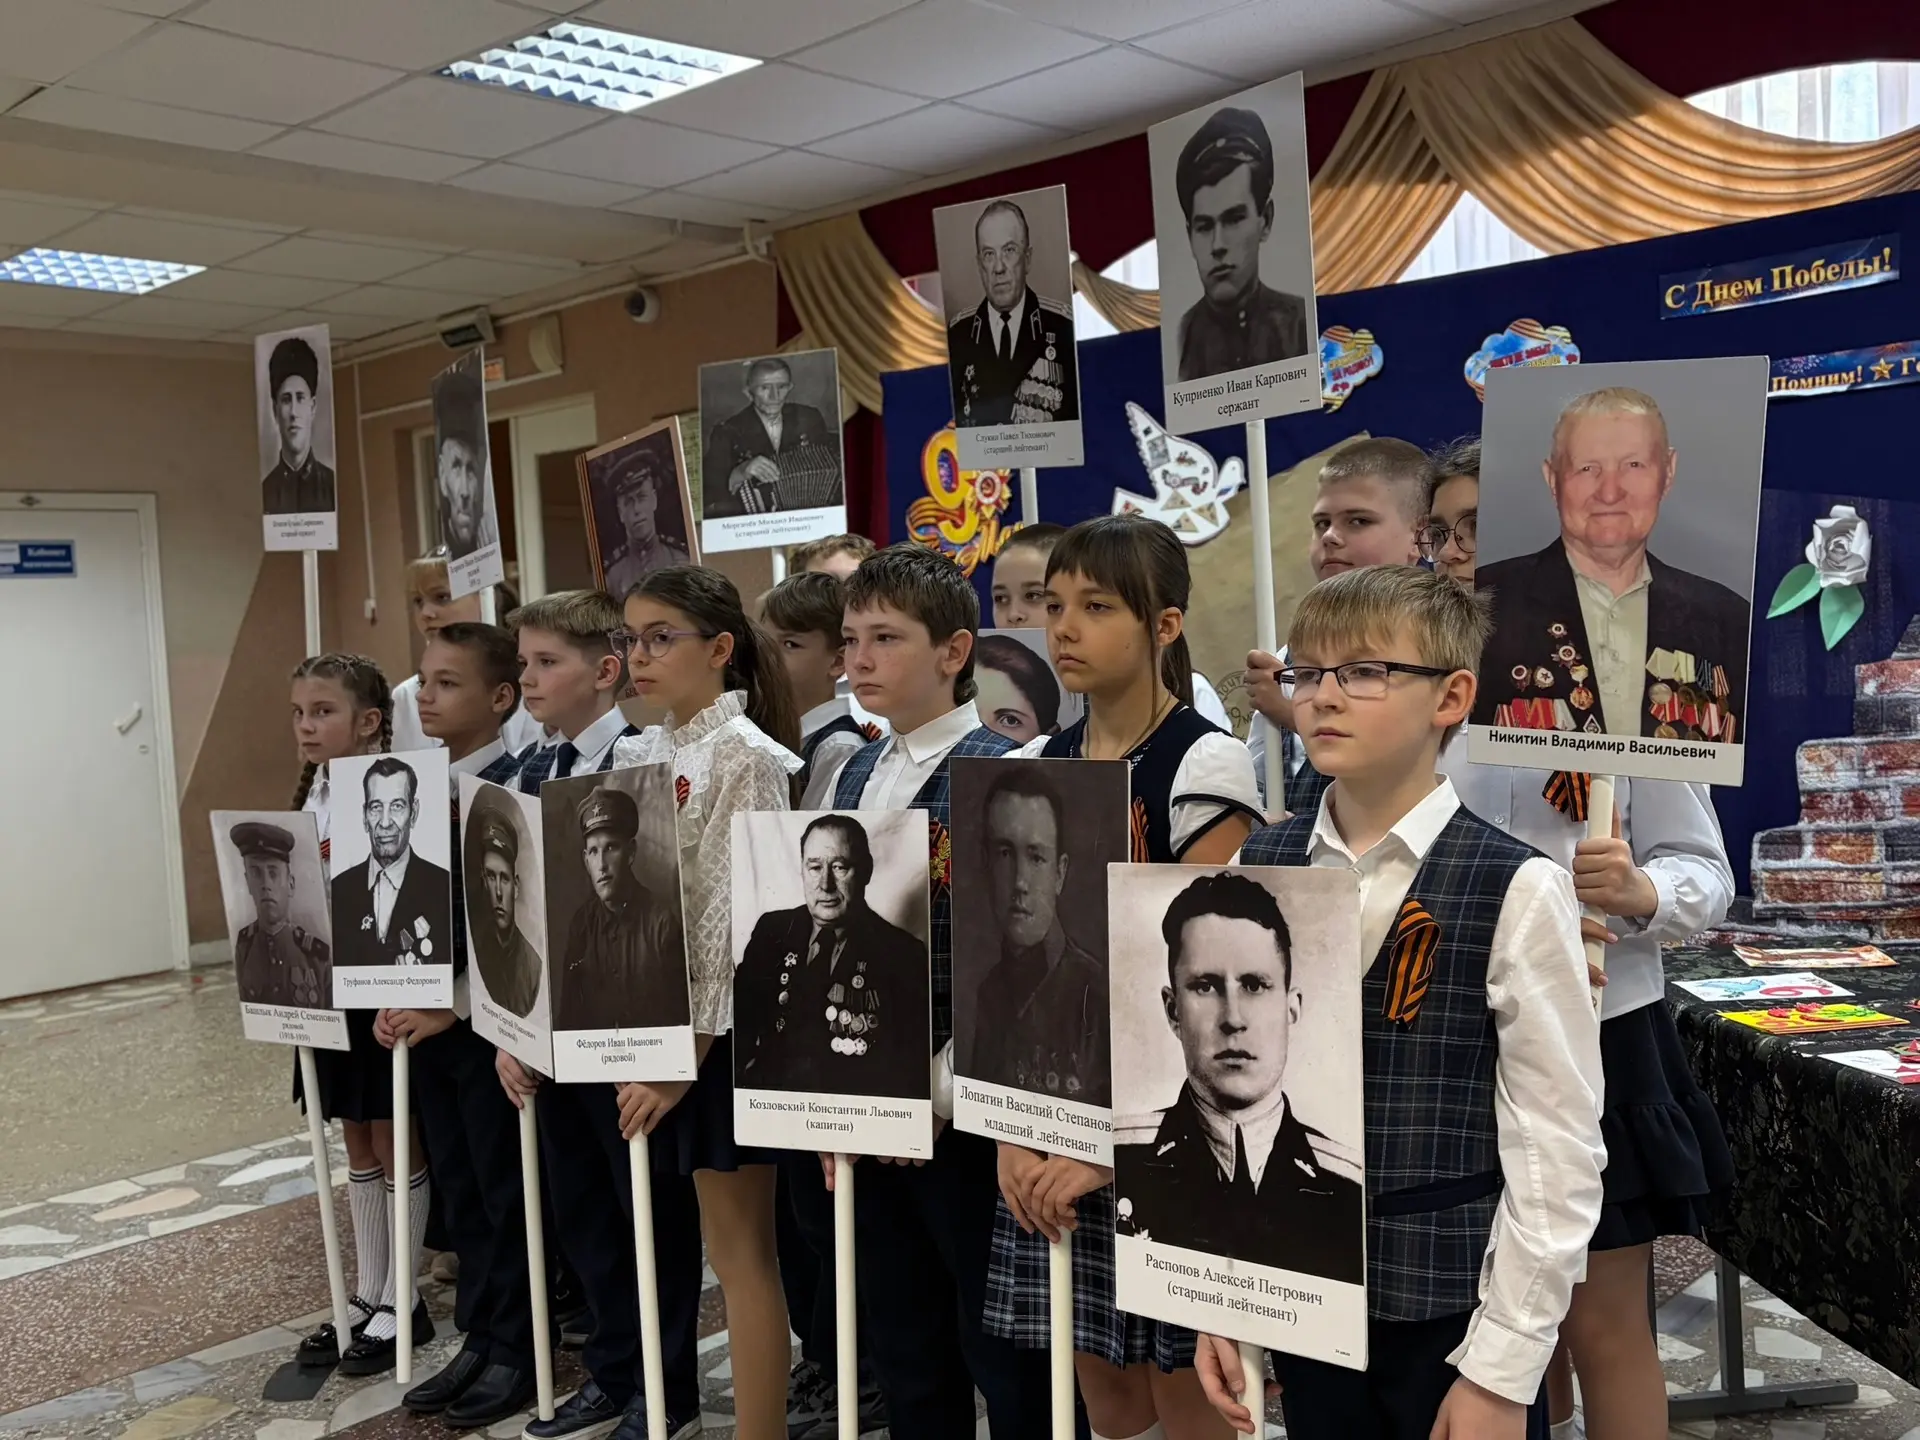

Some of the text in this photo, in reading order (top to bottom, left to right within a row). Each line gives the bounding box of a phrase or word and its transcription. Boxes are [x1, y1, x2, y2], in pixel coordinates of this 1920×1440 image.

[1664, 247, 1892, 310] С Днем Победы!
[1173, 368, 1307, 405] Куприенко Иван Карпович
[1772, 365, 1863, 392] Помним!
[1217, 398, 1260, 416] сержант
[1488, 730, 1717, 760] Никитин Владимир Васильевич
[372, 977, 404, 987] Александр
[273, 1008, 300, 1020] Андрей
[576, 1037, 663, 1050] Фёдоров Иван Иванович
[601, 1053, 636, 1065] (рядовой)
[749, 1099, 912, 1120] Козловский Константин Львович
[960, 1085, 1113, 1132] Лопатин Василий Степанов
[805, 1119, 854, 1134] (капитан)
[984, 1118, 1034, 1140] младший
[1145, 1253, 1323, 1306] Распопов Алексей Петрович
[1167, 1280, 1298, 1327] (старший лейтенант)
